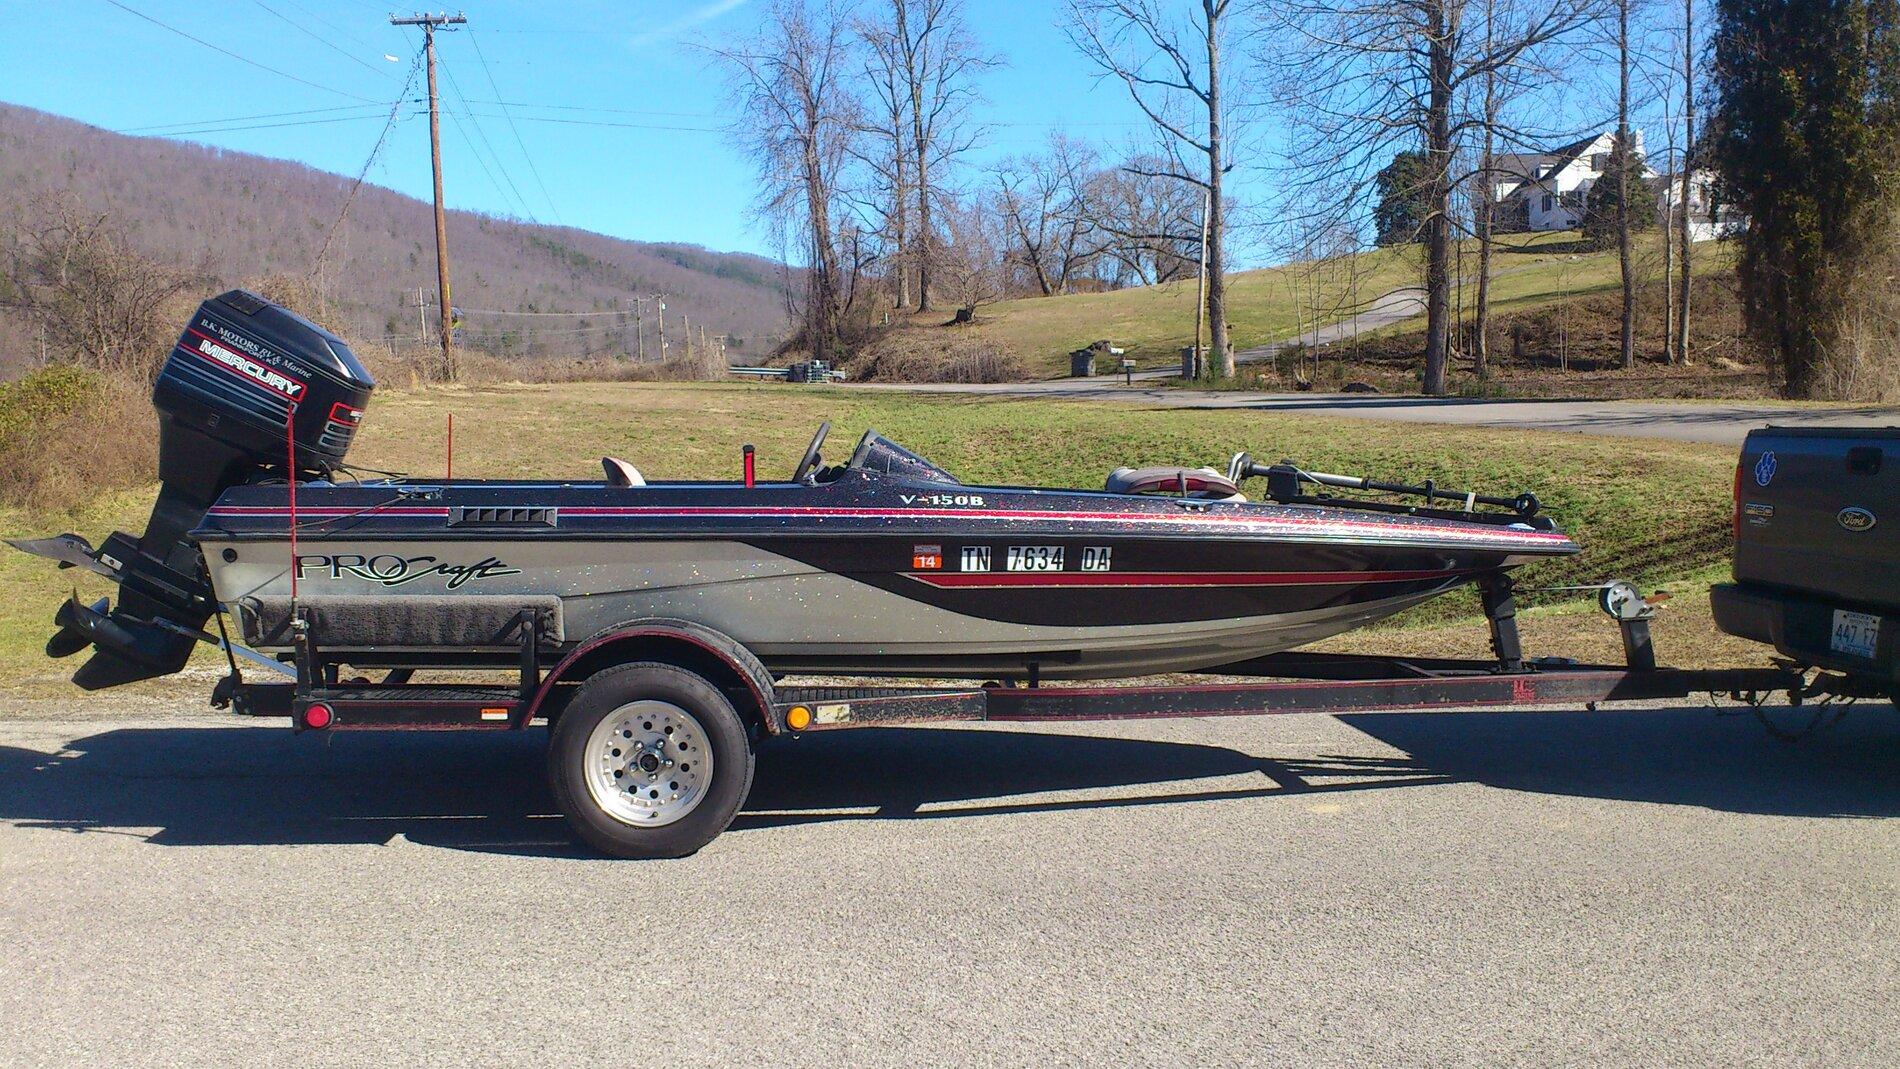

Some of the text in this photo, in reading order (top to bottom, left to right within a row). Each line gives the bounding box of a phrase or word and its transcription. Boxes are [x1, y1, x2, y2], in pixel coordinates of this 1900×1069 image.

[218, 326, 260, 352] MOTORS
[259, 347, 276, 359] RV
[272, 354, 283, 365] &
[282, 359, 313, 379] Marine
[199, 339, 302, 395] MERCURY
[900, 494, 984, 506] V-150B
[1844, 511, 1867, 527] Ford
[916, 555, 936, 568] 14
[963, 547, 1111, 571] TN 7634 DA
